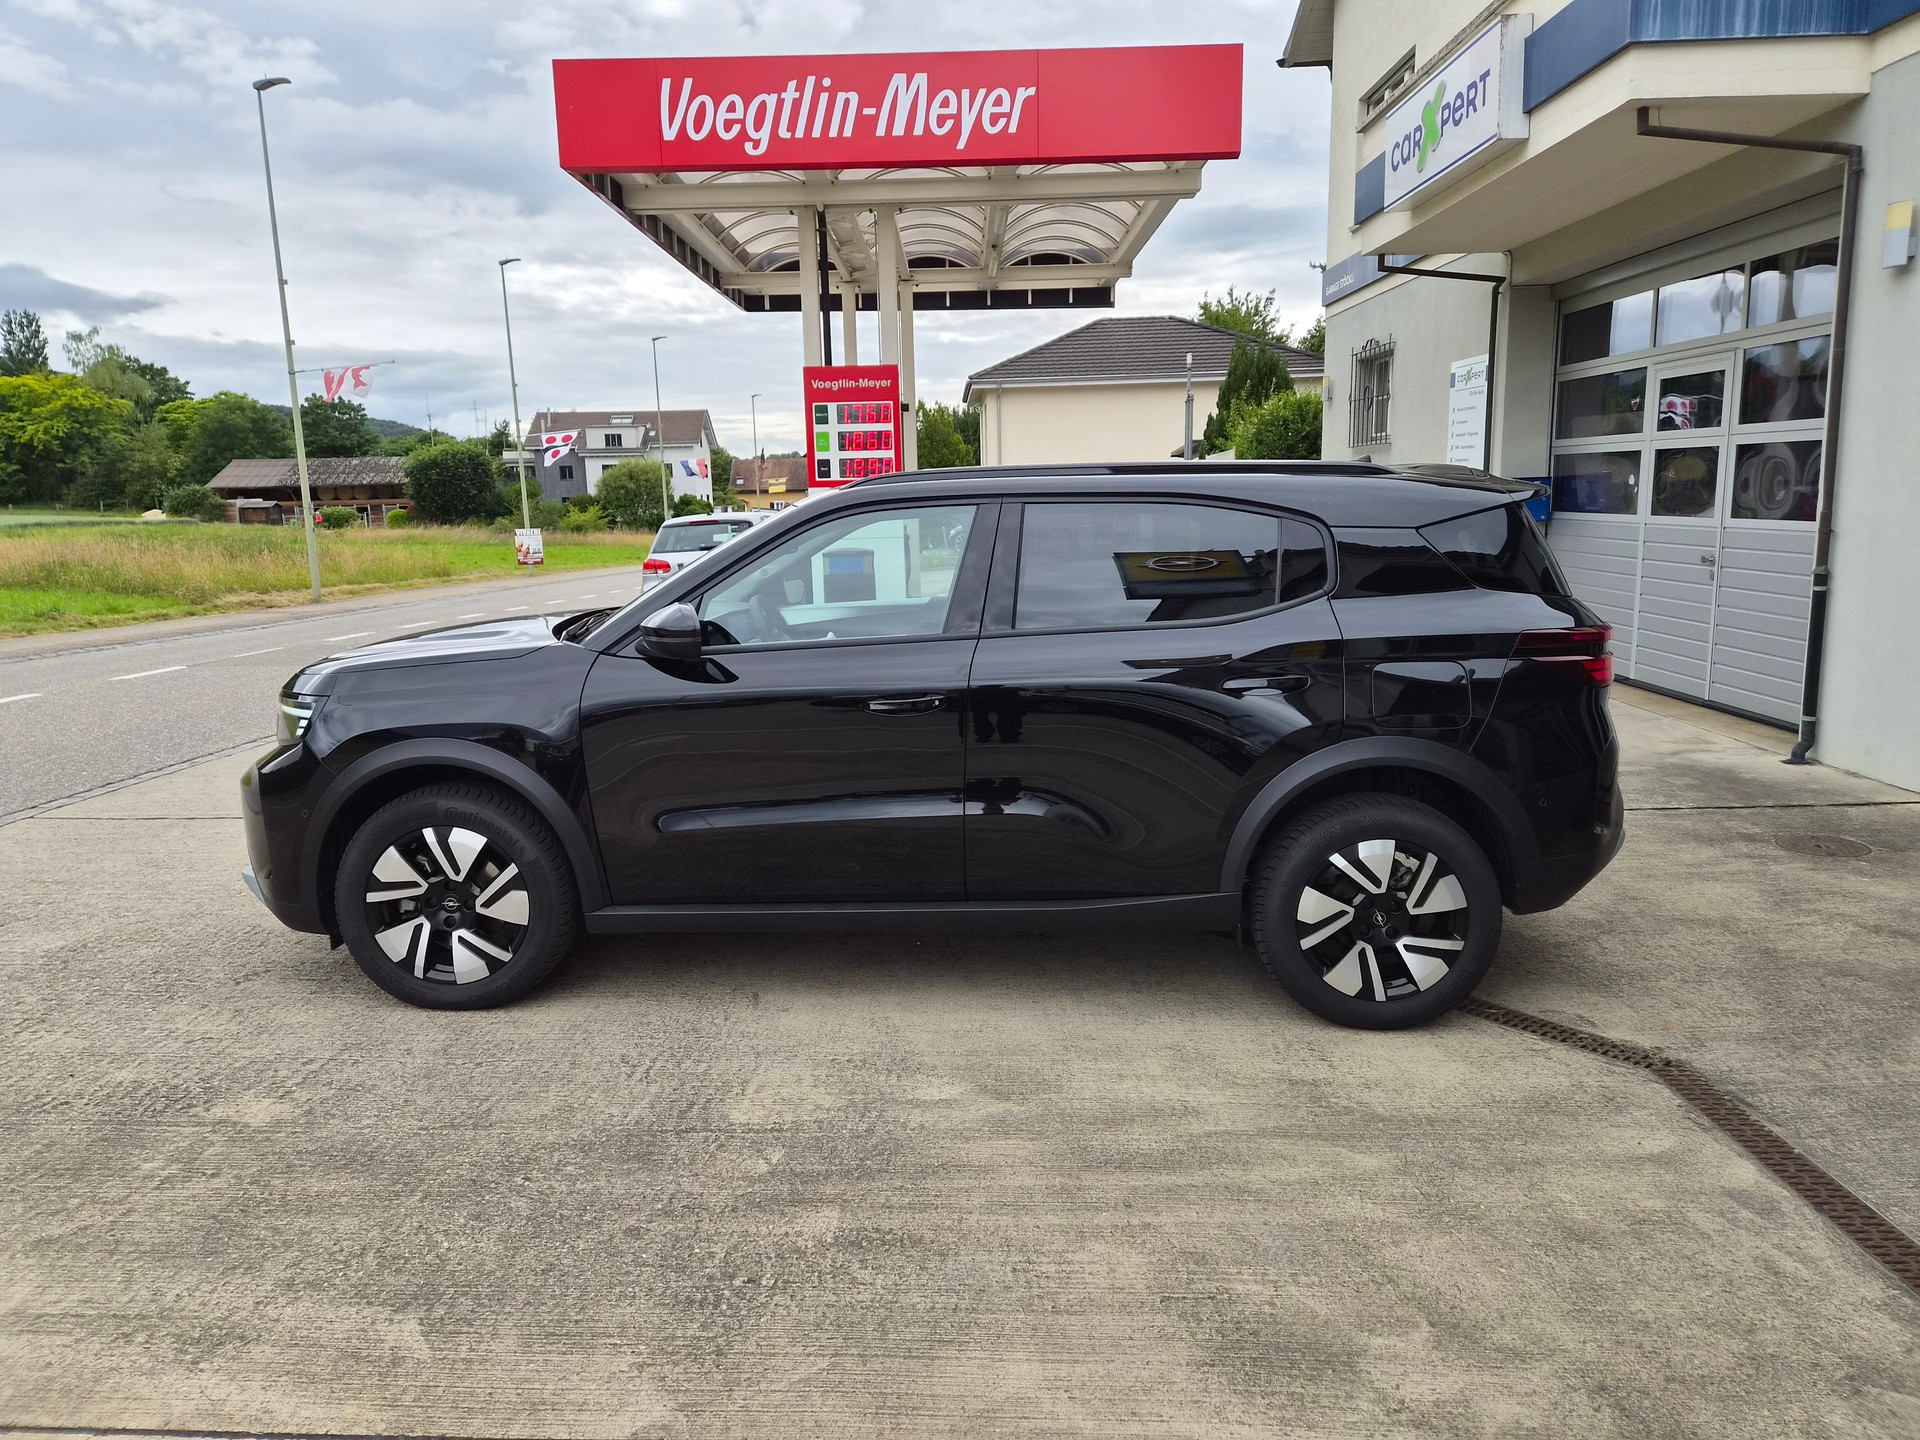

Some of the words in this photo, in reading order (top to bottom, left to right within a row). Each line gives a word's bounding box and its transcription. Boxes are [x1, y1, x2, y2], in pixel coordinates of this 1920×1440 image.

[660, 72, 1036, 156] Voegtlin-Meyer
[1326, 280, 1340, 295] GARAGE
[811, 378, 892, 390] Voegtlin-Meyer
[844, 404, 892, 424] 1.760
[845, 431, 893, 451] 1.860
[443, 806, 520, 848] Continental
